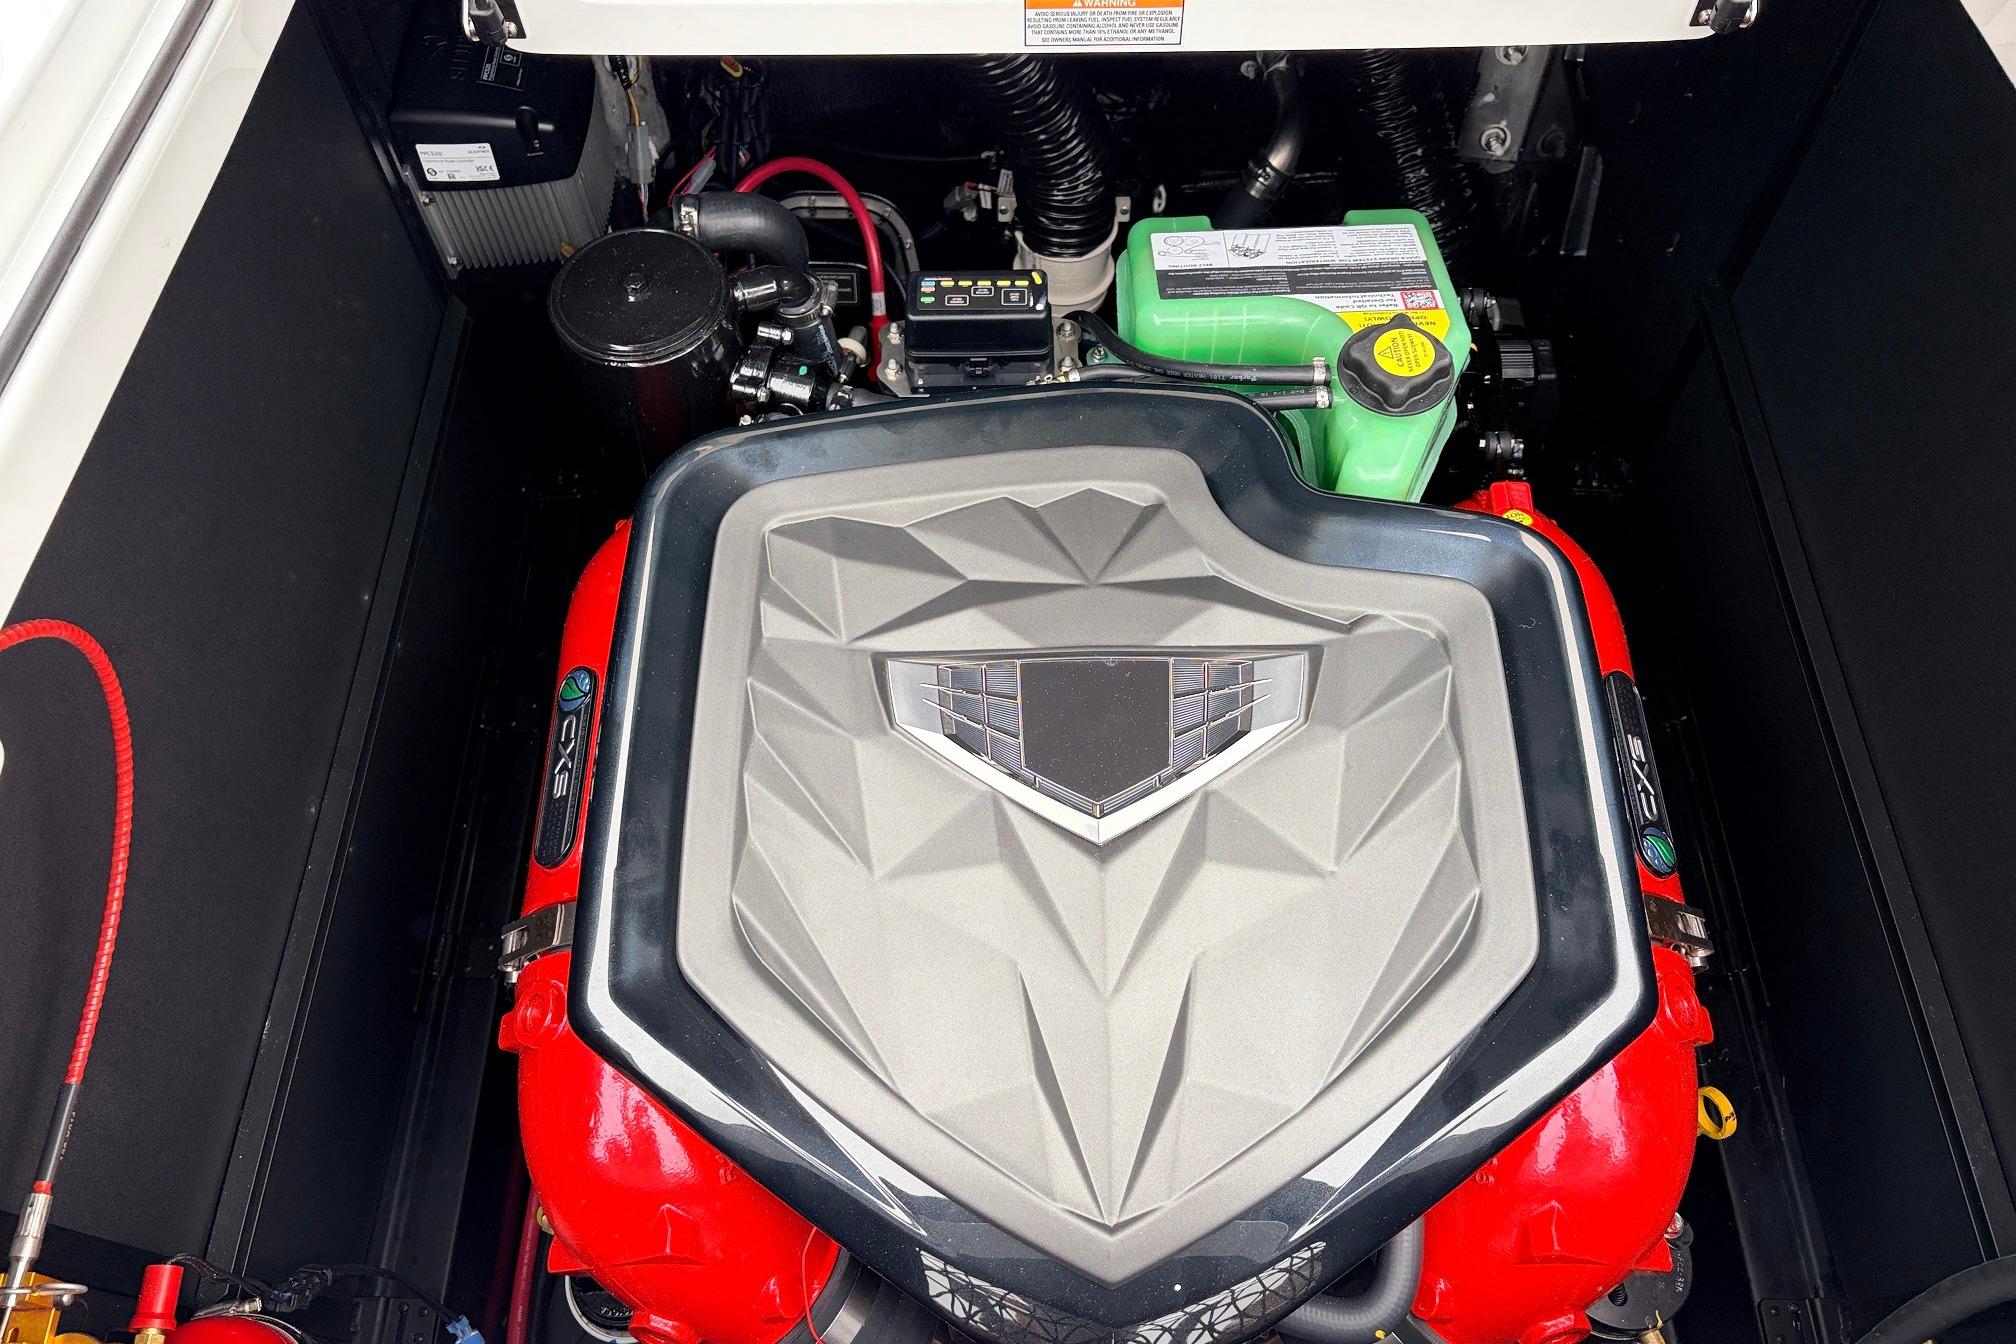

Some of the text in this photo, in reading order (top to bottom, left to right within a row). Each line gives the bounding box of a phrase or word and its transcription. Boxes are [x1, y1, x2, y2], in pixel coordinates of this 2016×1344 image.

[1391, 338, 1404, 367] CAUTION
[553, 714, 576, 799] CXS
[1627, 734, 1659, 822] CXS
